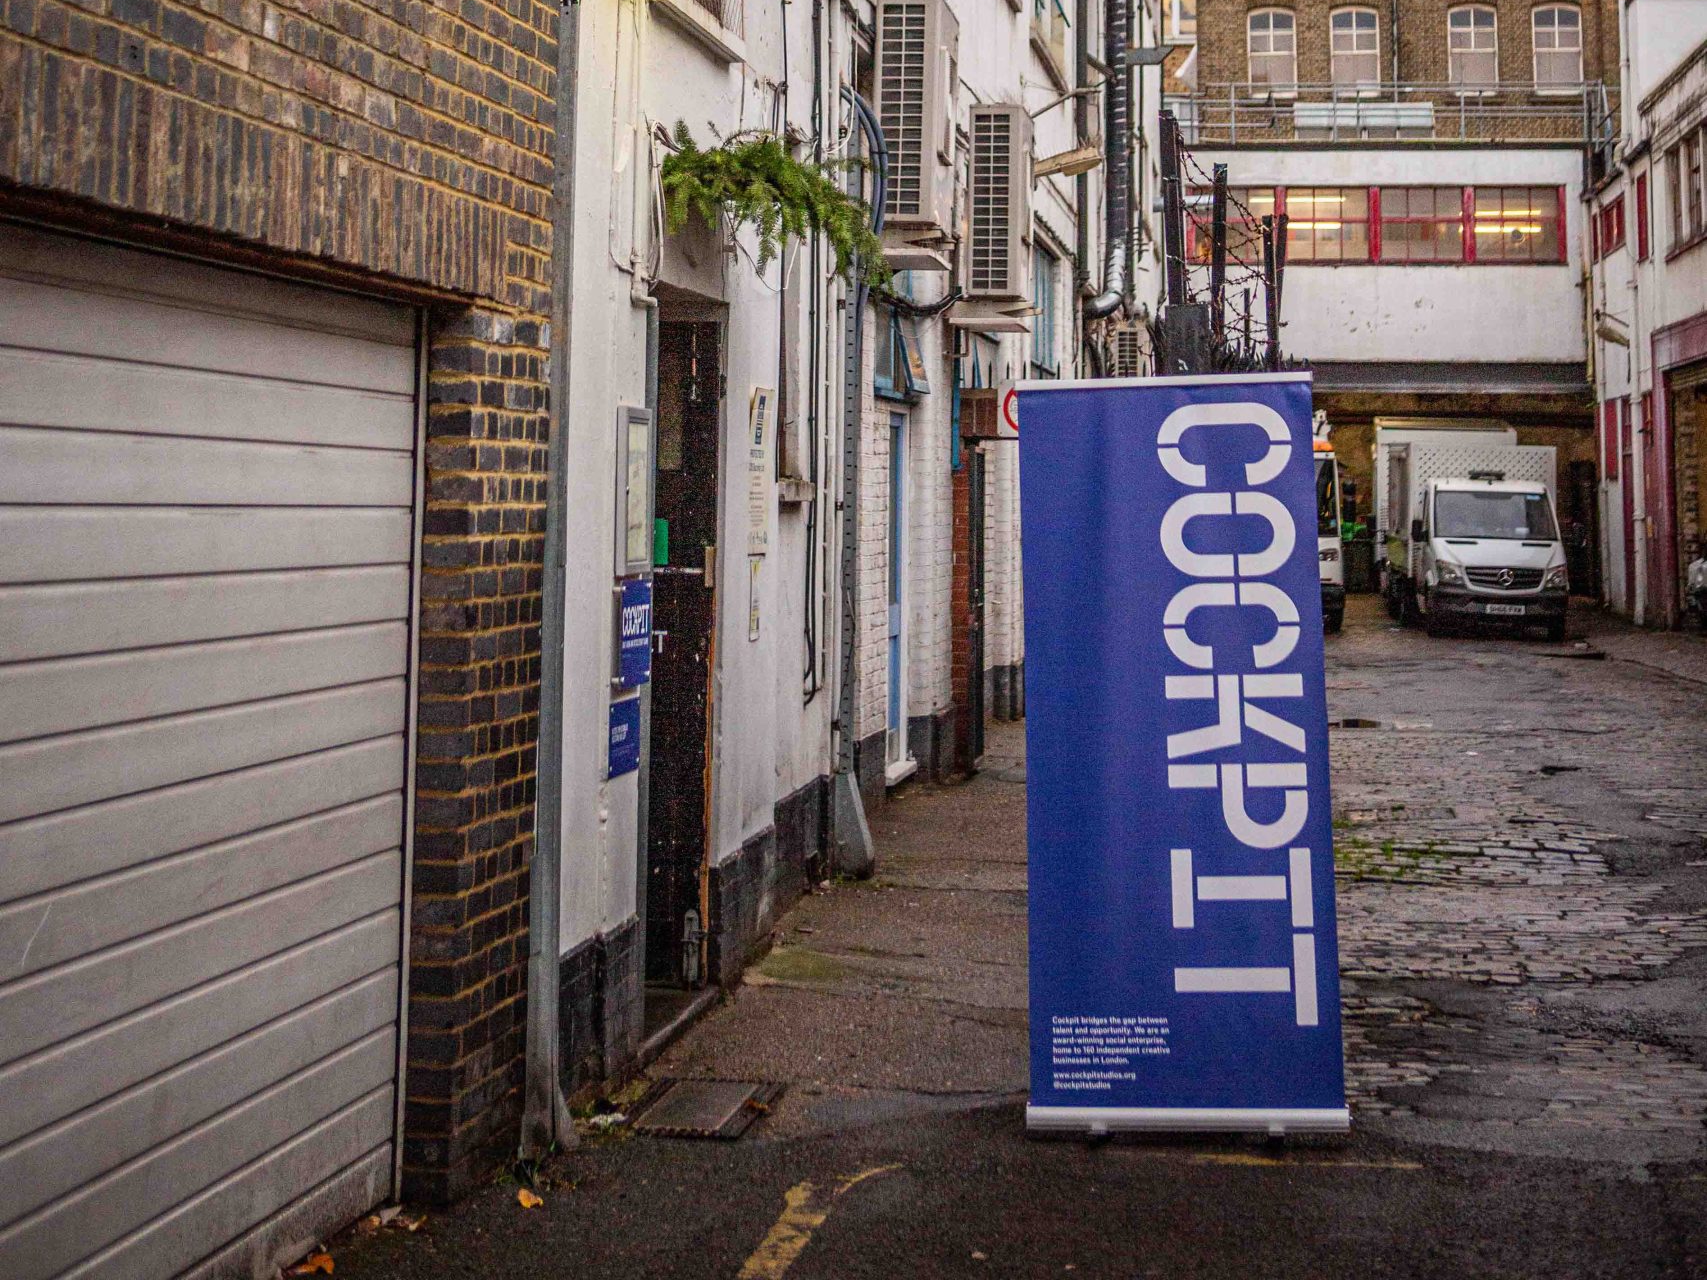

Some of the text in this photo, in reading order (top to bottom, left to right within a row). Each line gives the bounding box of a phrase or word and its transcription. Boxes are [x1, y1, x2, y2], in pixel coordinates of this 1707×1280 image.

[622, 604, 650, 636] COCKPIT
[1157, 401, 1318, 1026] COCKPIT
[1053, 1016, 1079, 1025] Cockpit
[1081, 1016, 1107, 1025] bridges
[1138, 1016, 1167, 1024] between
[1053, 1026, 1073, 1034] talent
[1090, 1027, 1132, 1035] opportunity.
[1053, 1036, 1103, 1045] award-winning
[1128, 1037, 1166, 1045] enterprise,
[1053, 1046, 1071, 1054] home
[1096, 1047, 1140, 1055] independent
[1053, 1056, 1091, 1064] businesses
[1093, 1056, 1099, 1064] in
[1053, 1071, 1136, 1080] www.cockpitstudios.org
[1054, 1082, 1111, 1090] @cockpitstudios
